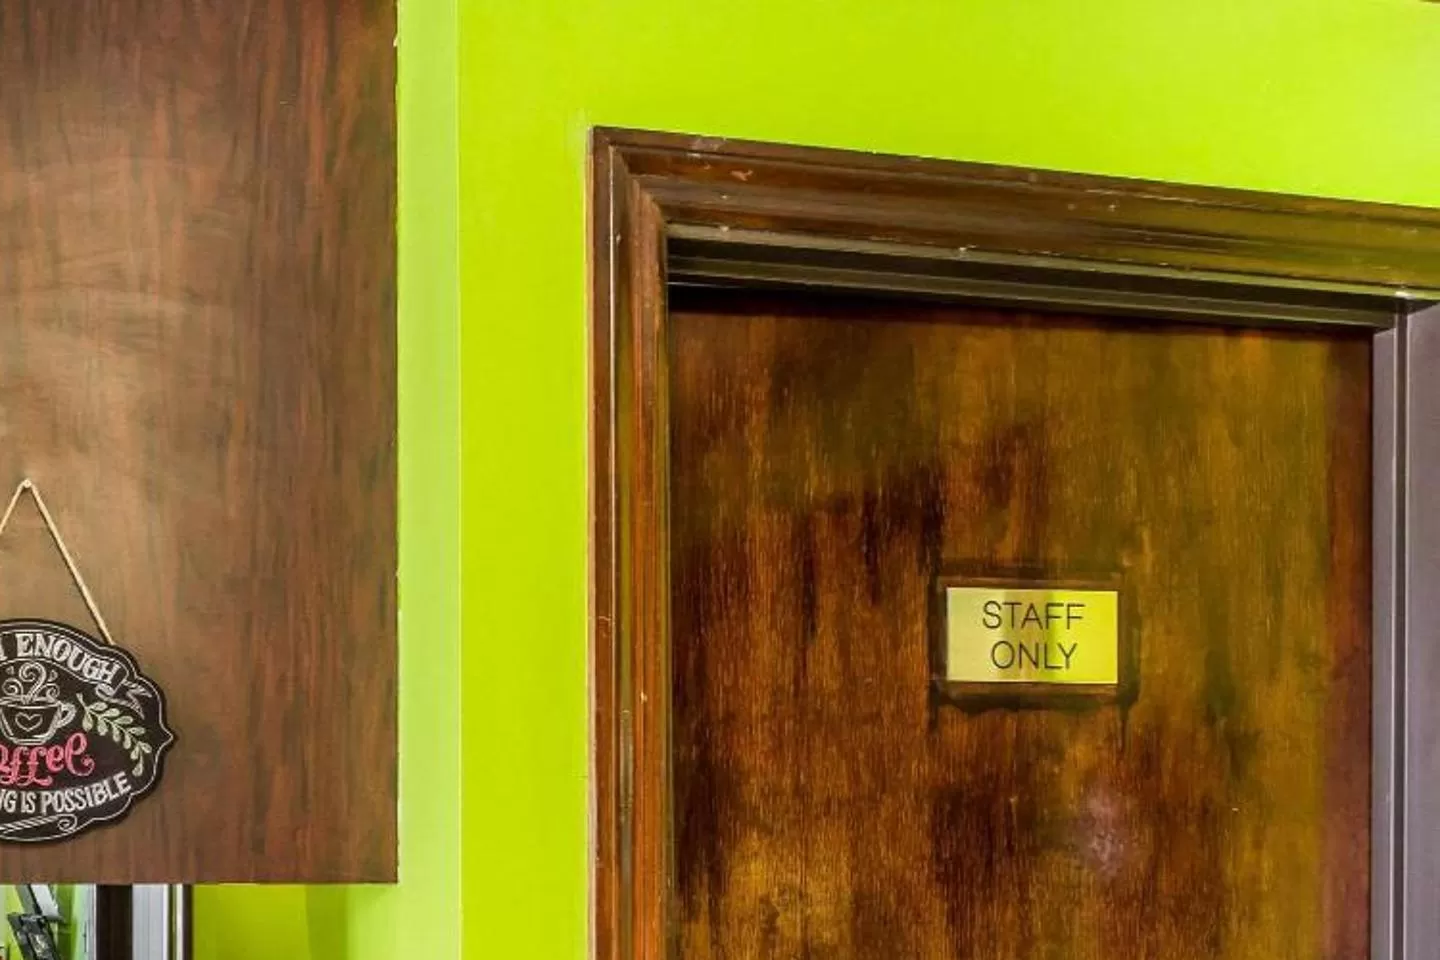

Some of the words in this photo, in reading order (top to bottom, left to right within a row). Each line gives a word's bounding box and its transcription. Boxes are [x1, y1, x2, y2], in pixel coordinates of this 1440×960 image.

[982, 600, 1086, 630] STAFF
[14, 632, 122, 686] ENOUGH
[990, 640, 1078, 670] ONLY
[20, 790, 37, 814] IS
[40, 771, 132, 816] POSSIBLE
